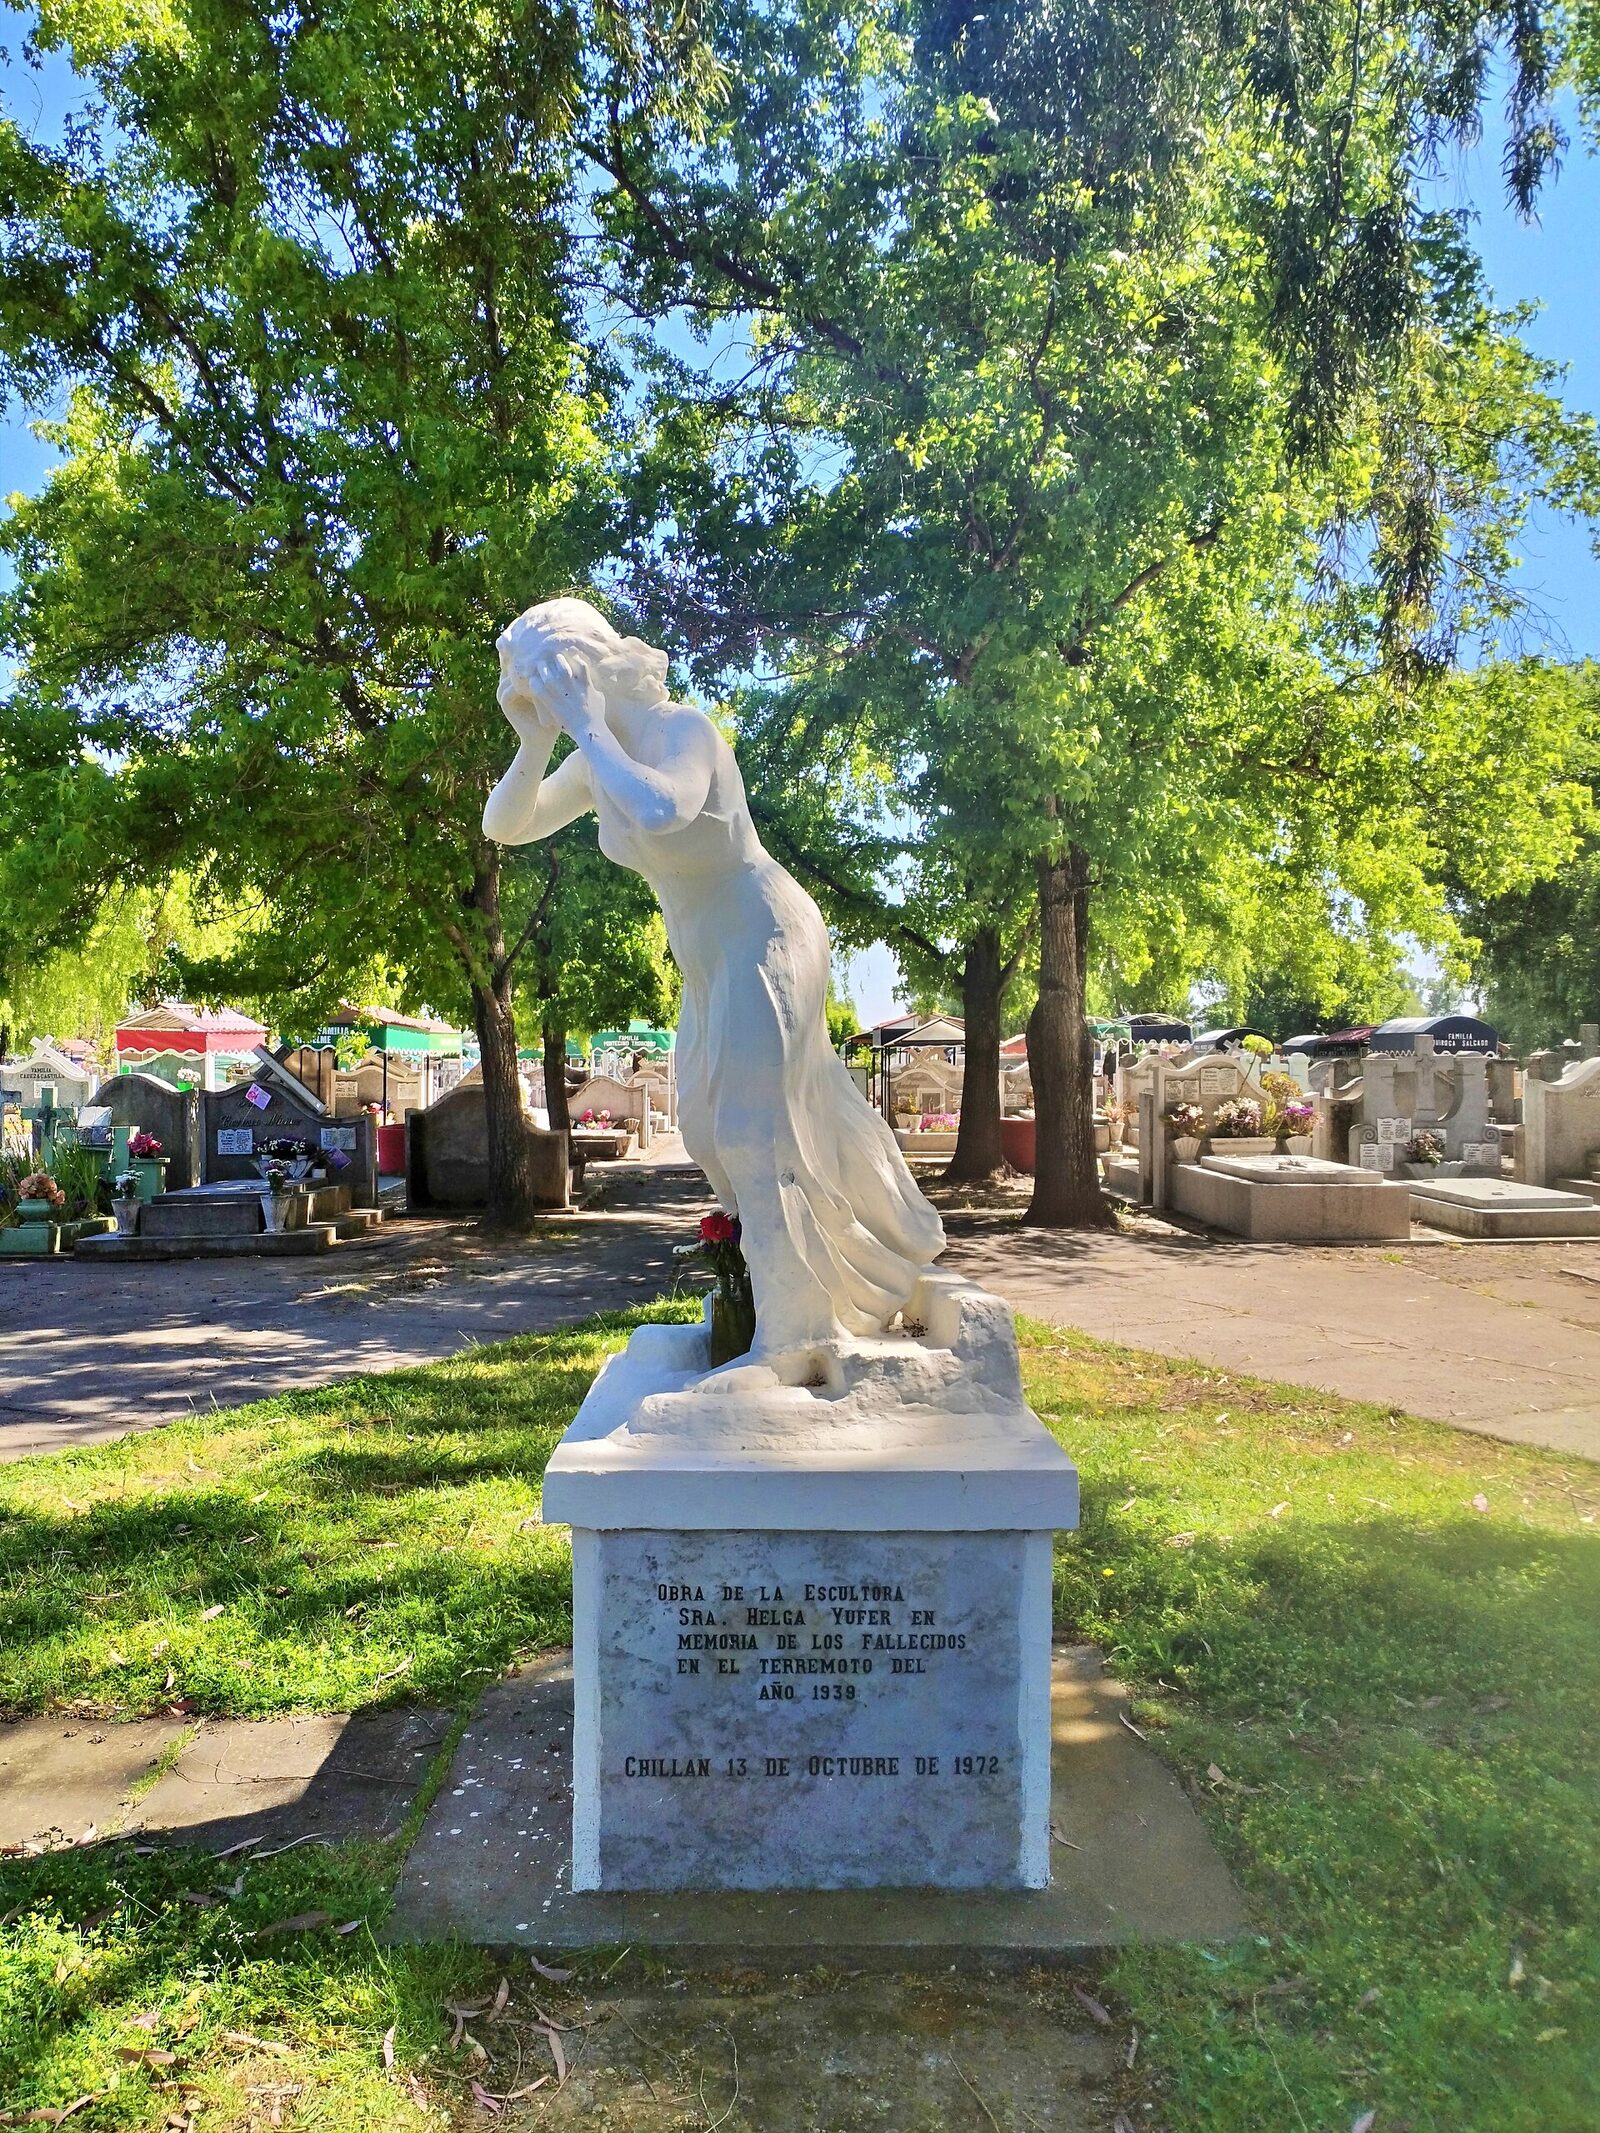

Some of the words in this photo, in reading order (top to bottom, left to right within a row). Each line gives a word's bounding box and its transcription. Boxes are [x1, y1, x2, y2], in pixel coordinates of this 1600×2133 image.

[658, 1585, 704, 1601] OBRA
[723, 1587, 743, 1600] DE
[760, 1587, 784, 1601] LA
[805, 1585, 903, 1601] ESCULTORA
[680, 1608, 726, 1625] SRA.
[747, 1608, 805, 1625] HELGA
[832, 1608, 890, 1625] YUFER
[912, 1611, 935, 1625] EN
[679, 1634, 757, 1649] MEMORIA
[777, 1635, 796, 1649] DE
[813, 1634, 842, 1649] LOS
[863, 1634, 965, 1649] FALLECIDOS
[678, 1659, 699, 1673] EN
[718, 1659, 739, 1674] EL
[760, 1659, 872, 1674] TERREMOTO
[892, 1659, 925, 1673] DEL
[760, 1682, 794, 1700] AÑO
[813, 1685, 855, 1700] 1939
[626, 1757, 709, 1777] CHILLAN
[729, 1759, 746, 1776] 13
[766, 1758, 789, 1776] DE
[809, 1756, 898, 1776] OCTUBRE
[915, 1757, 938, 1775] DE
[955, 1757, 998, 1774] 1972
